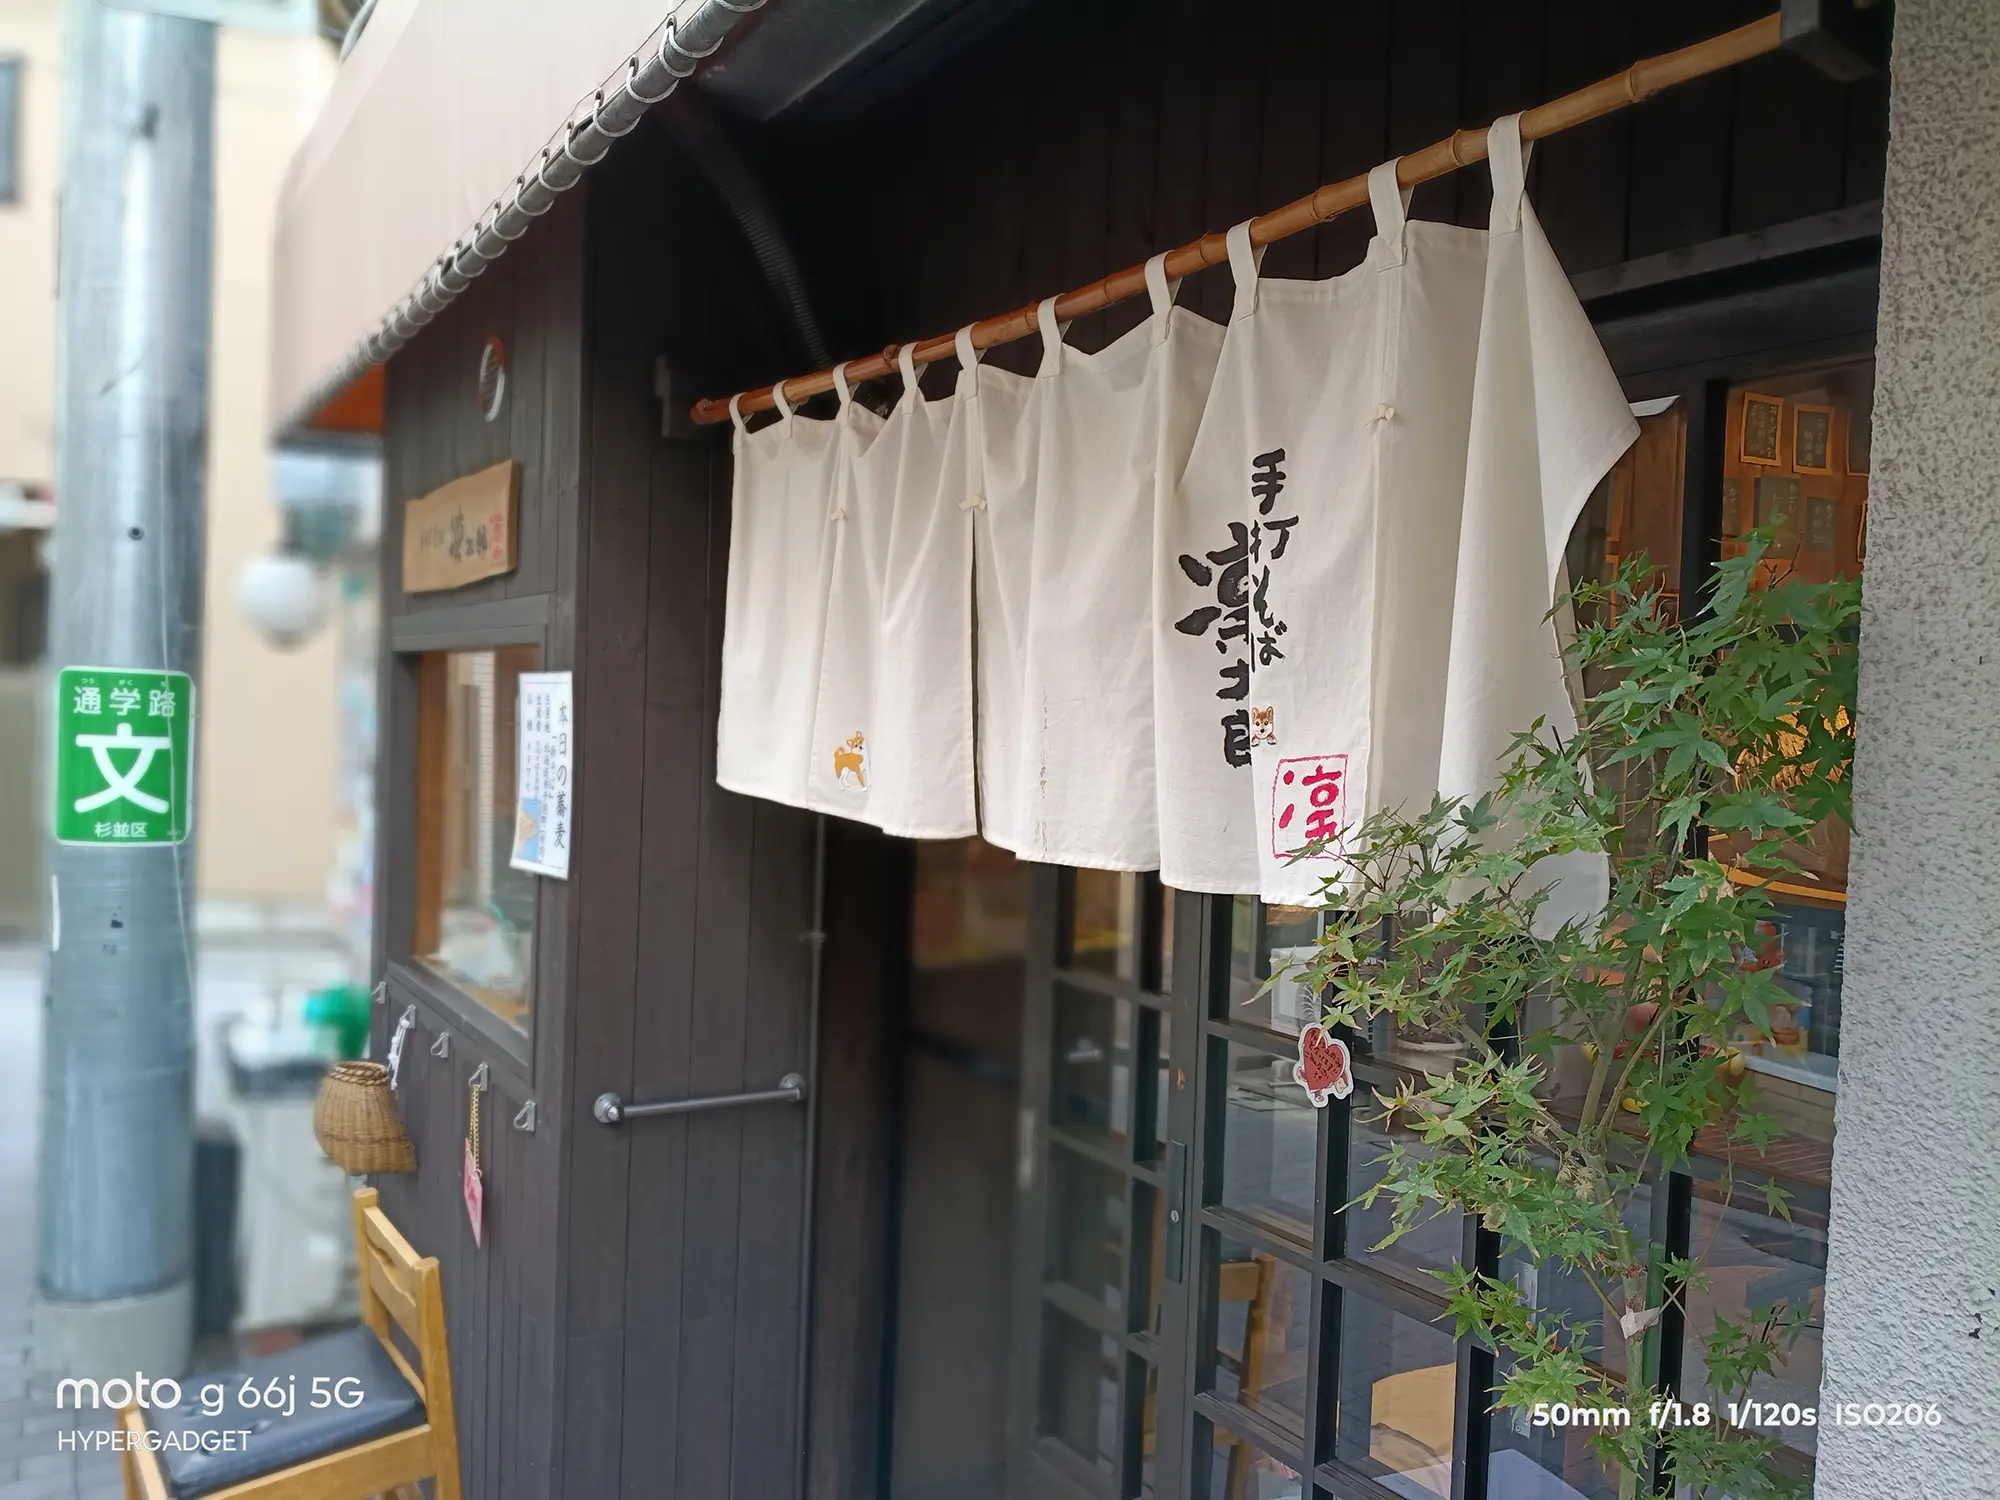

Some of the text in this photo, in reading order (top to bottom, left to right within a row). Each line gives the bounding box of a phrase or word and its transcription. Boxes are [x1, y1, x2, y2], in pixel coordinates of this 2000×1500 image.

[73, 685, 176, 717] 通学路
[74, 722, 171, 814] 文
[554, 700, 569, 849] 本日の蕎麦
[94, 821, 148, 838] 杉並区
